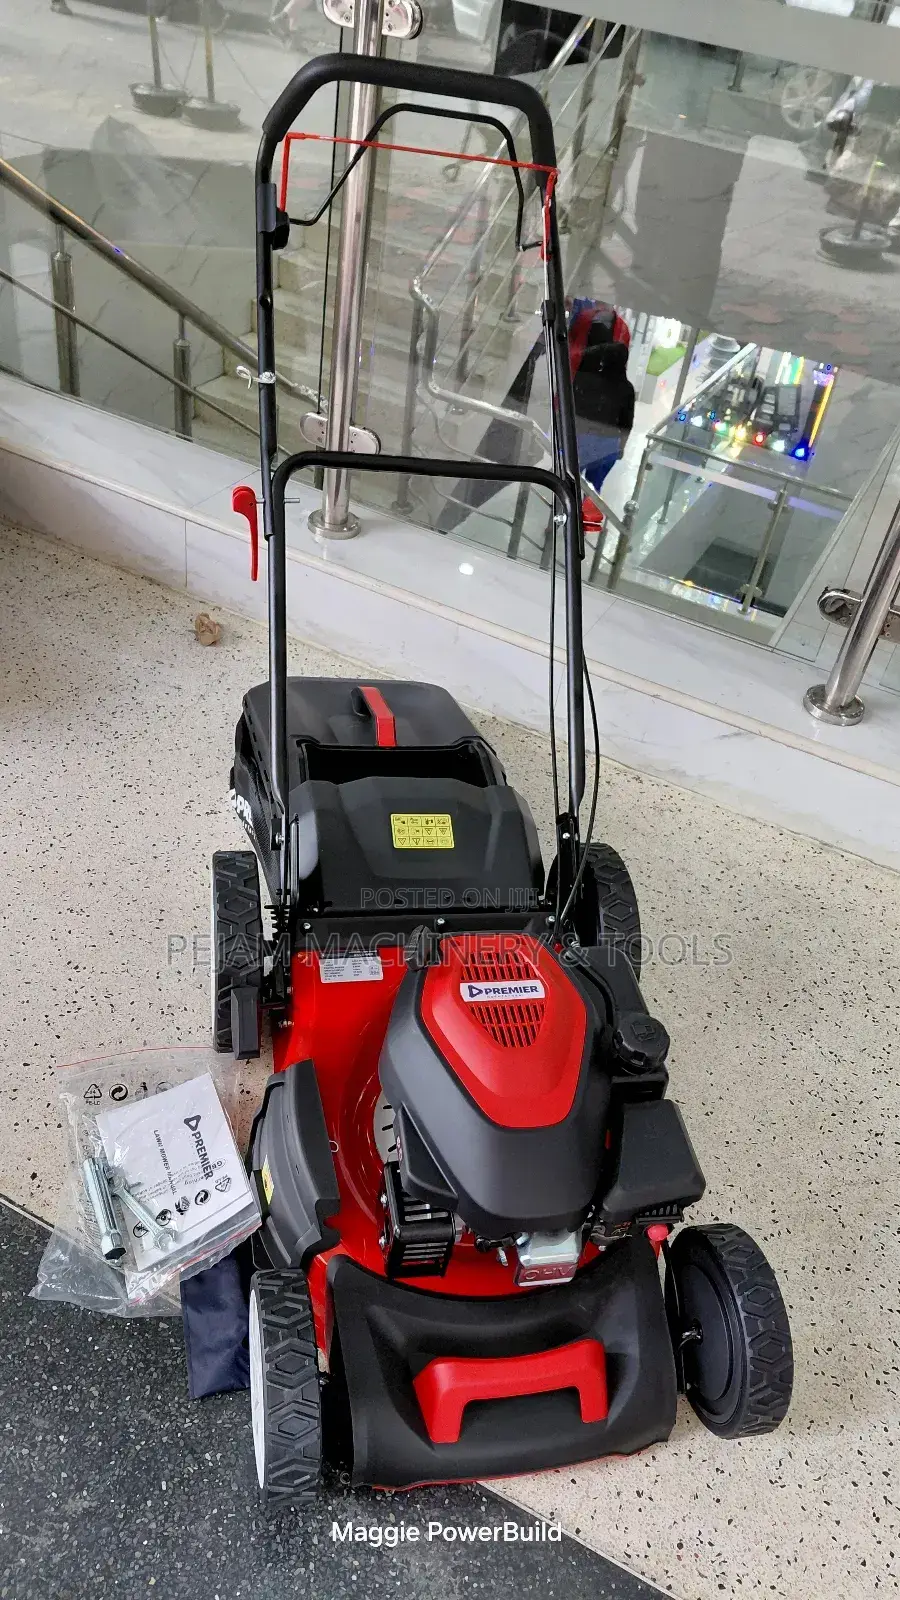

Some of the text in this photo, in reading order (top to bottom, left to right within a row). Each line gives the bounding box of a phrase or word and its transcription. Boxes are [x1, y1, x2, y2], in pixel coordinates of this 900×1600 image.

[484, 985, 539, 995] PREMIER
[160, 1148, 170, 1171] MOWER
[192, 1131, 214, 1180] PREMIER
